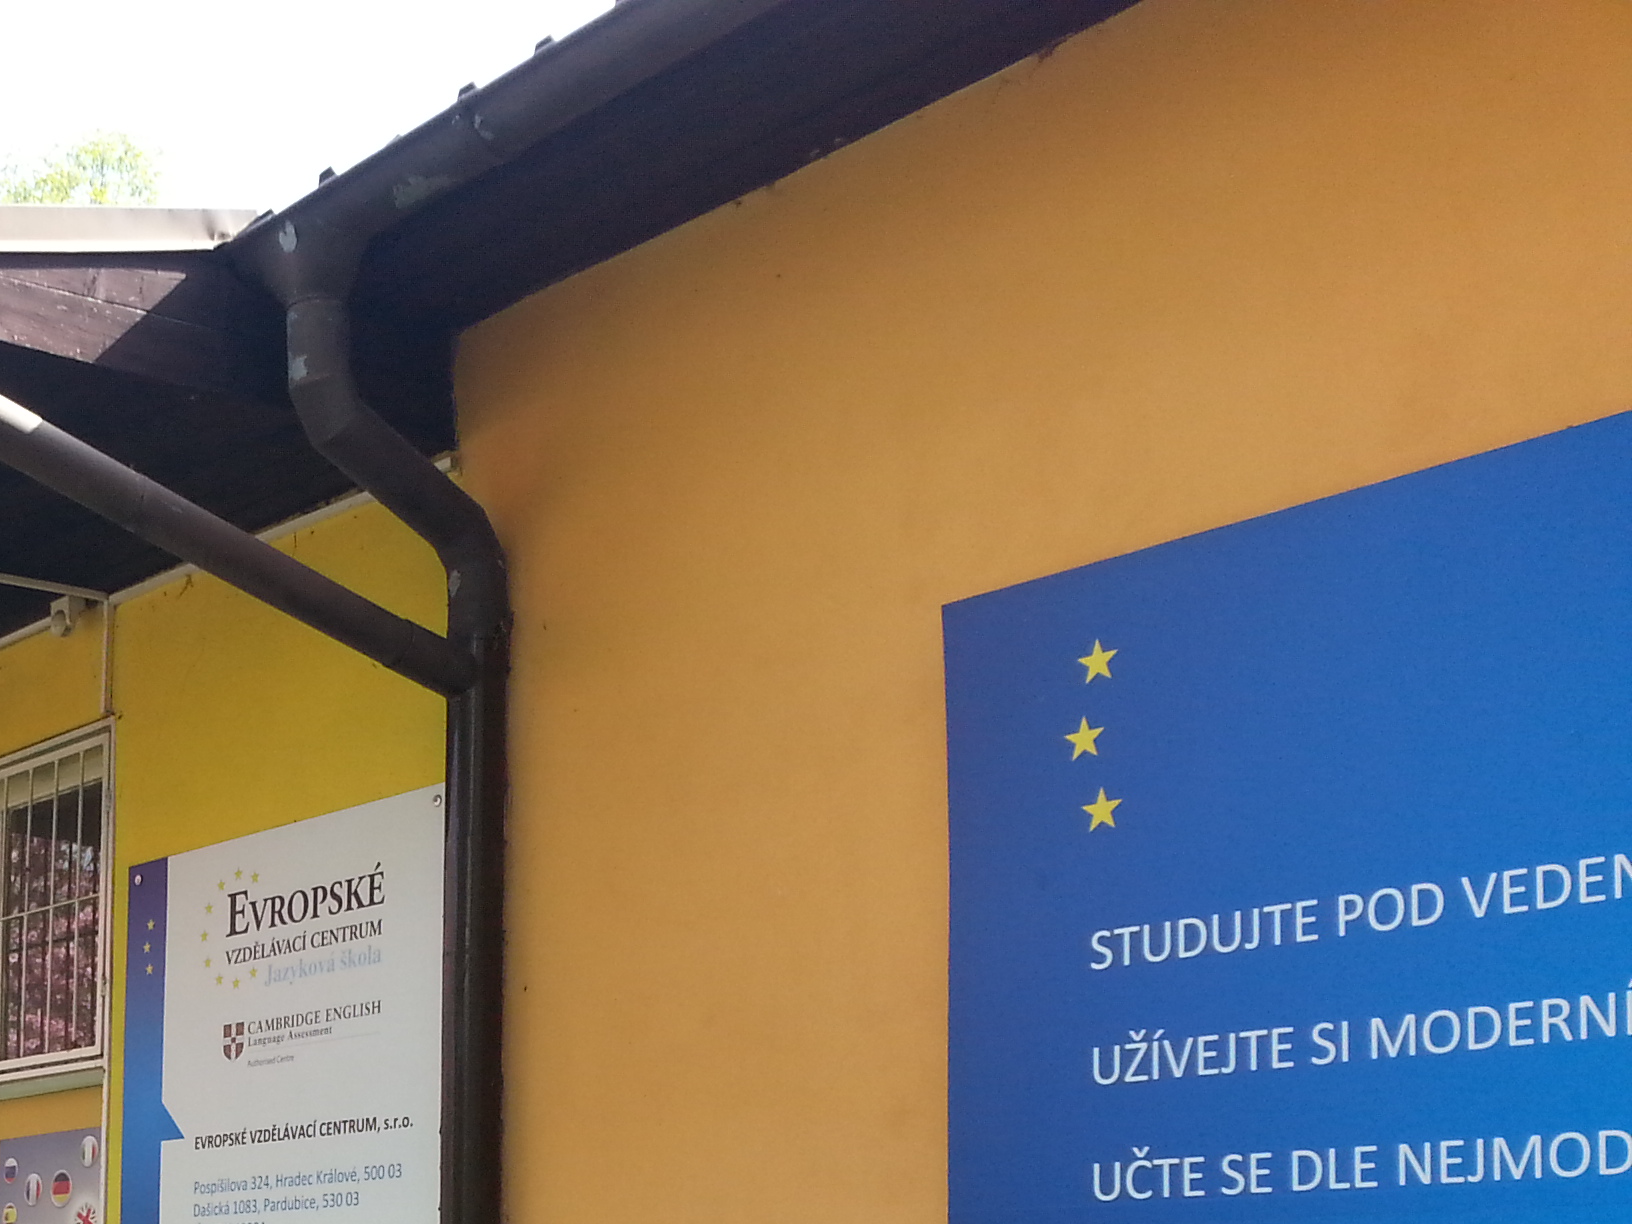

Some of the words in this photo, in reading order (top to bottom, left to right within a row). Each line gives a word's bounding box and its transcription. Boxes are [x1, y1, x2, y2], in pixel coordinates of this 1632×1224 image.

[225, 930, 307, 965] VZDĚLÁVACÍ
[310, 919, 383, 949] CENTRUM
[1089, 898, 1320, 970] STUDUJTE
[1337, 881, 1444, 938] POD
[264, 951, 335, 986] Jazyková
[340, 944, 381, 970] škola
[247, 1010, 321, 1035] CAMBRIDGE
[325, 1000, 382, 1023] ENGLISH
[248, 1033, 285, 1048] Language
[287, 1026, 333, 1041] Assessment
[1092, 1027, 1295, 1085] UŽÍVEJTE
[1311, 1020, 1349, 1065] SI
[194, 1128, 247, 1150] EVROPSKÉ
[250, 1119, 317, 1144] VZDĚLÁVACÍ
[319, 1116, 381, 1137] CENTRUM,
[383, 1115, 413, 1131] s.r.o.
[193, 1178, 248, 1196] Pospíšilova
[250, 1175, 273, 1191] 324,
[275, 1171, 313, 1188] Hradec
[316, 1167, 360, 1184] Králové,
[363, 1165, 385, 1181] 500
[388, 1163, 402, 1179] 03
[1092, 1146, 1206, 1202] UČTE
[1221, 1151, 1273, 1195] SE
[1292, 1144, 1379, 1192] DLE
[1398, 1129, 1632, 1186] NEJMOD
[193, 1201, 230, 1217] Dašická
[233, 1199, 260, 1215] 1083,
[263, 1195, 319, 1213] Pardubice,
[322, 1193, 343, 1208] 530
[346, 1191, 359, 1207] 03
